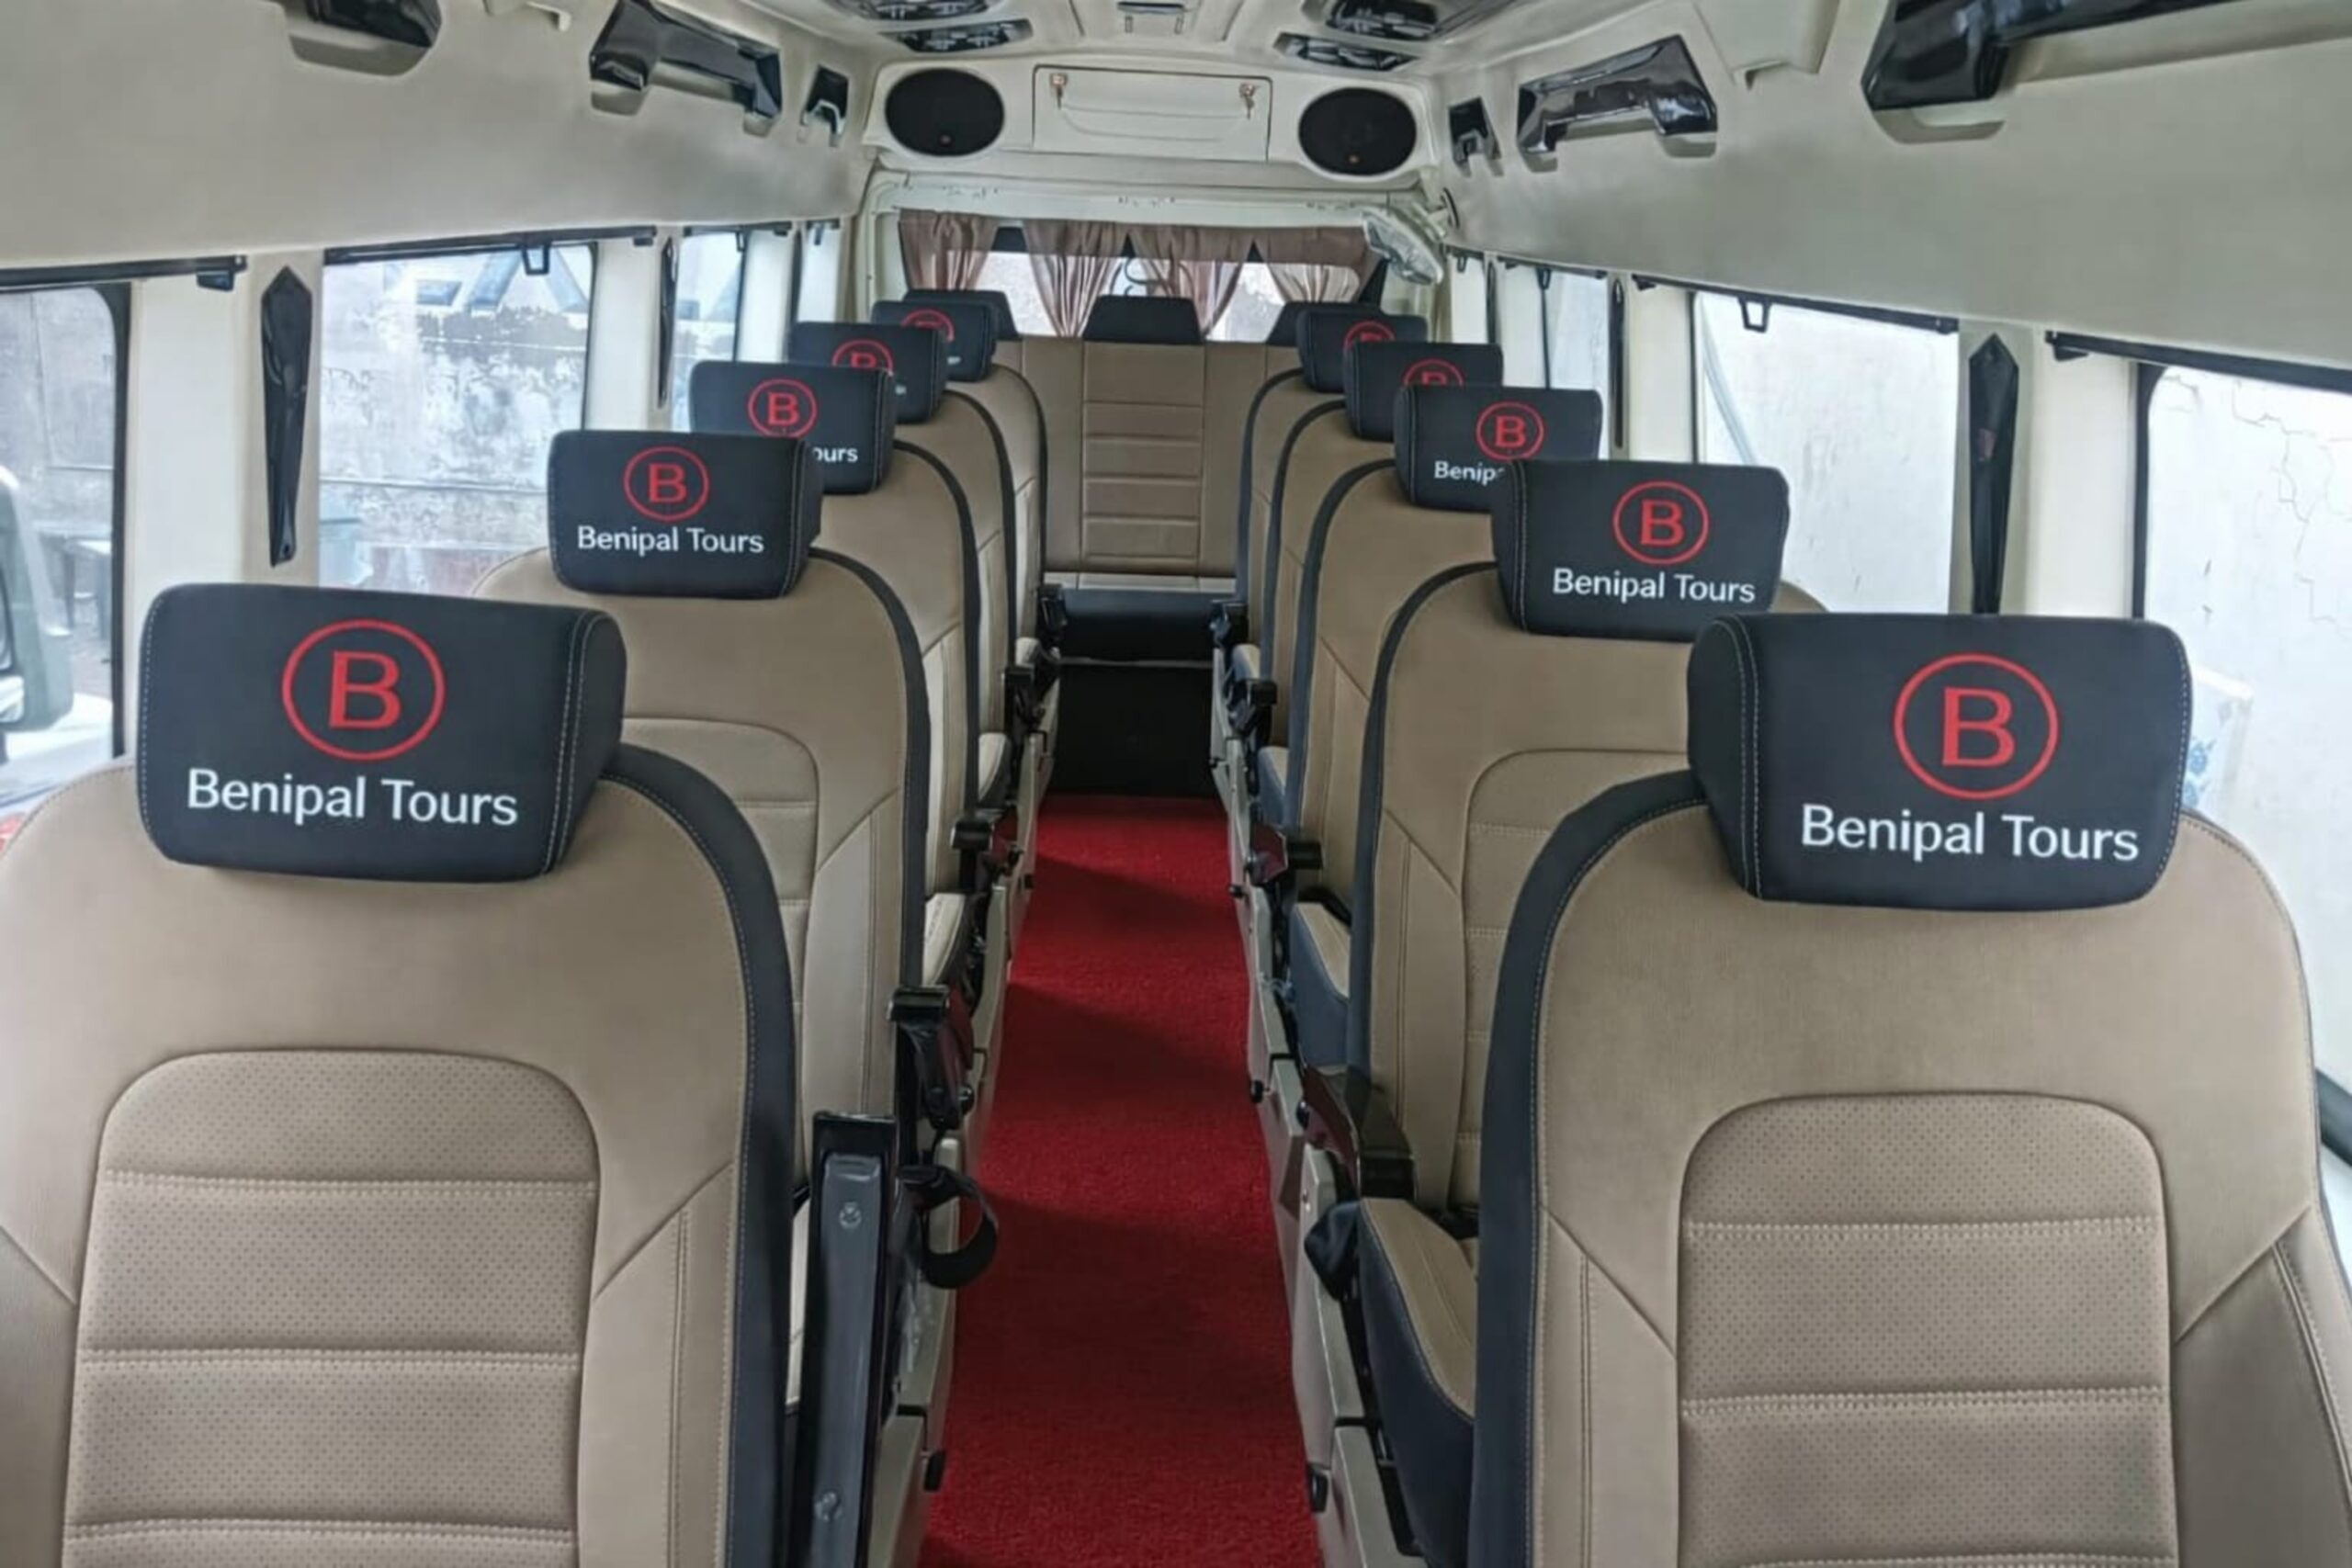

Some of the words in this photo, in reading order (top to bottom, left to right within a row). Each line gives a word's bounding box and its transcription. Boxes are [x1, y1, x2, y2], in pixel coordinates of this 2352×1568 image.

[768, 392, 799, 425] B
[1495, 415, 1526, 448] B
[812, 446, 859, 463] ours
[1434, 460, 1505, 487] Benip
[647, 462, 689, 504] B
[577, 525, 679, 557] Benipal
[686, 526, 764, 554] Tours
[1640, 499, 1686, 547] B
[1552, 568, 1666, 604] Benipal
[1674, 573, 1756, 604] Tours
[329, 651, 401, 729] B
[1942, 687, 2017, 767] B
[187, 768, 366, 826] Benipal
[380, 778, 517, 826] Tours
[1802, 804, 1984, 863] Benipal
[2001, 814, 2139, 862] Tours
